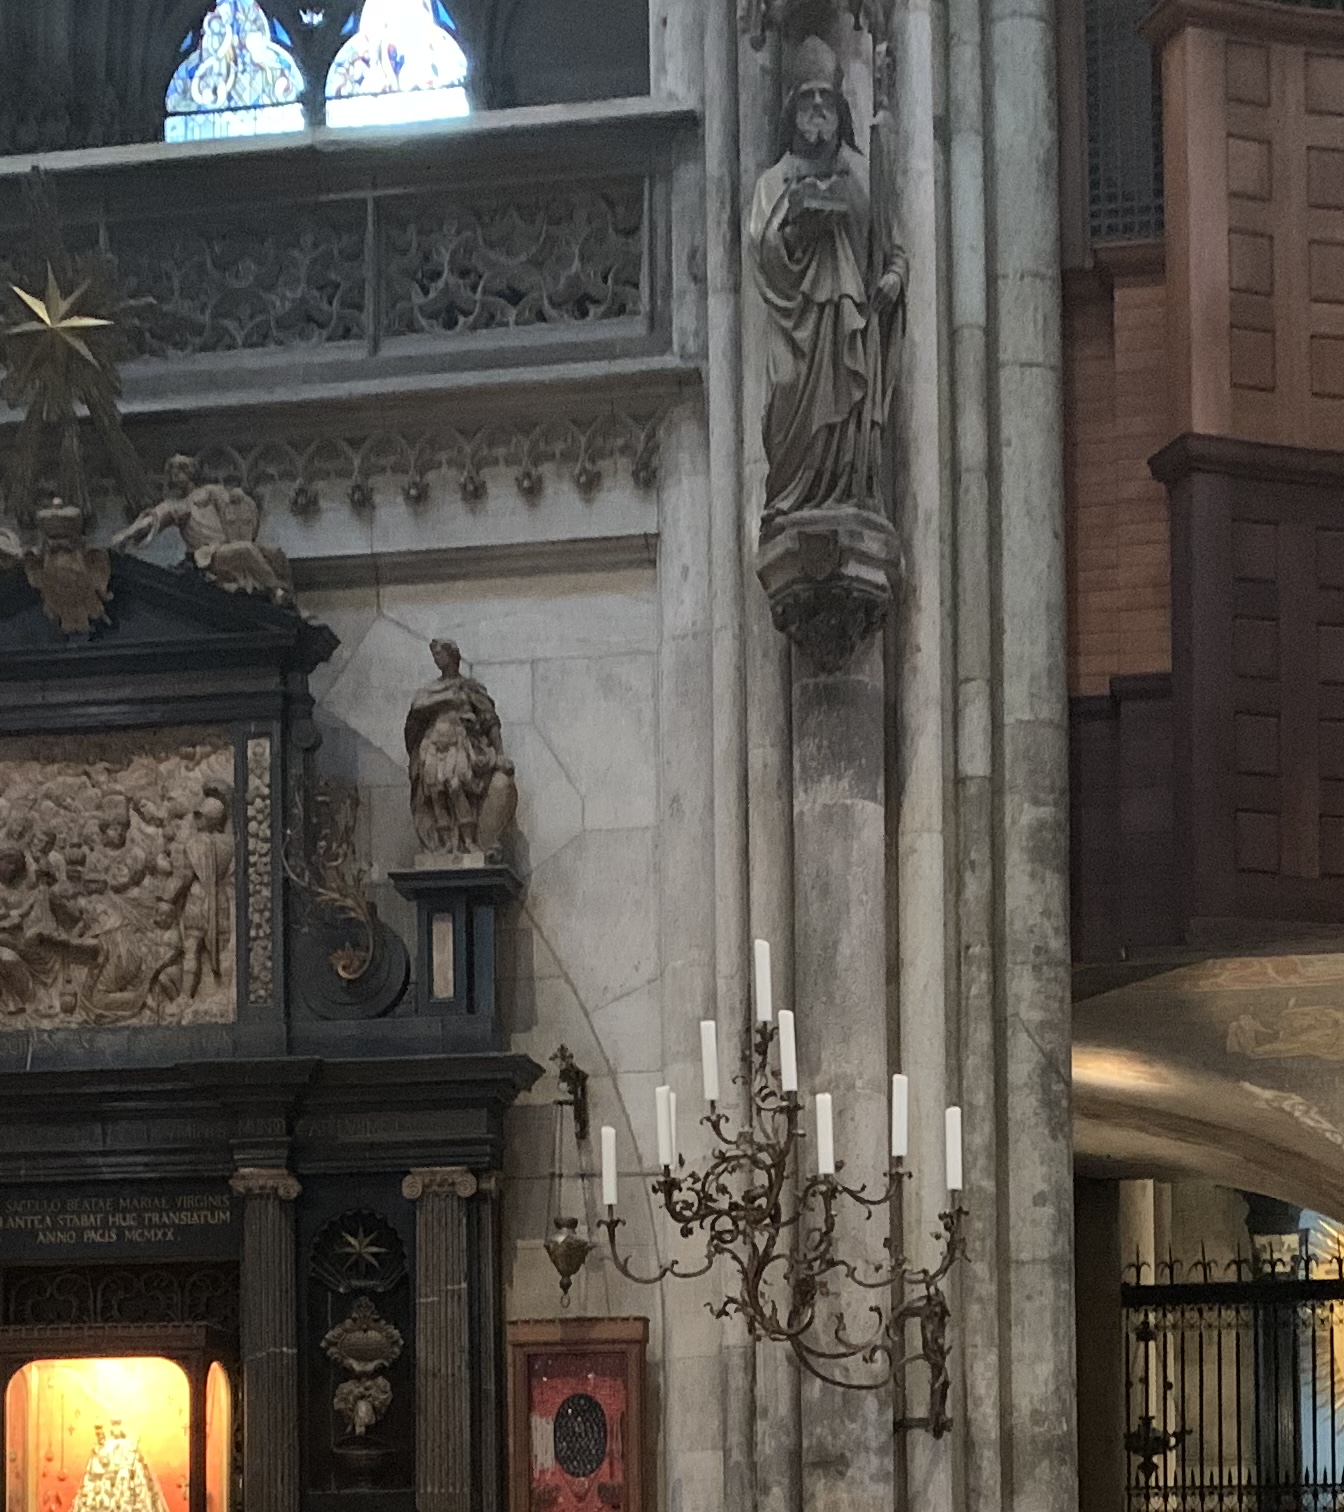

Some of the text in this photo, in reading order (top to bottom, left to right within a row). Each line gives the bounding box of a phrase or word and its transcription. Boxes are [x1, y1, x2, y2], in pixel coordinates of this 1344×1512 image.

[67, 1197, 114, 1211] BEATAE
[119, 1195, 171, 1210] MARIAE
[174, 1194, 230, 1208] VIRGINIS
[6, 1214, 52, 1229] ANTEA
[57, 1213, 104, 1227] STABAT
[108, 1212, 138, 1227] HUC
[144, 1209, 230, 1226] TRANSLATUM
[36, 1230, 76, 1245] ANNO
[83, 1228, 118, 1243] PACIS
